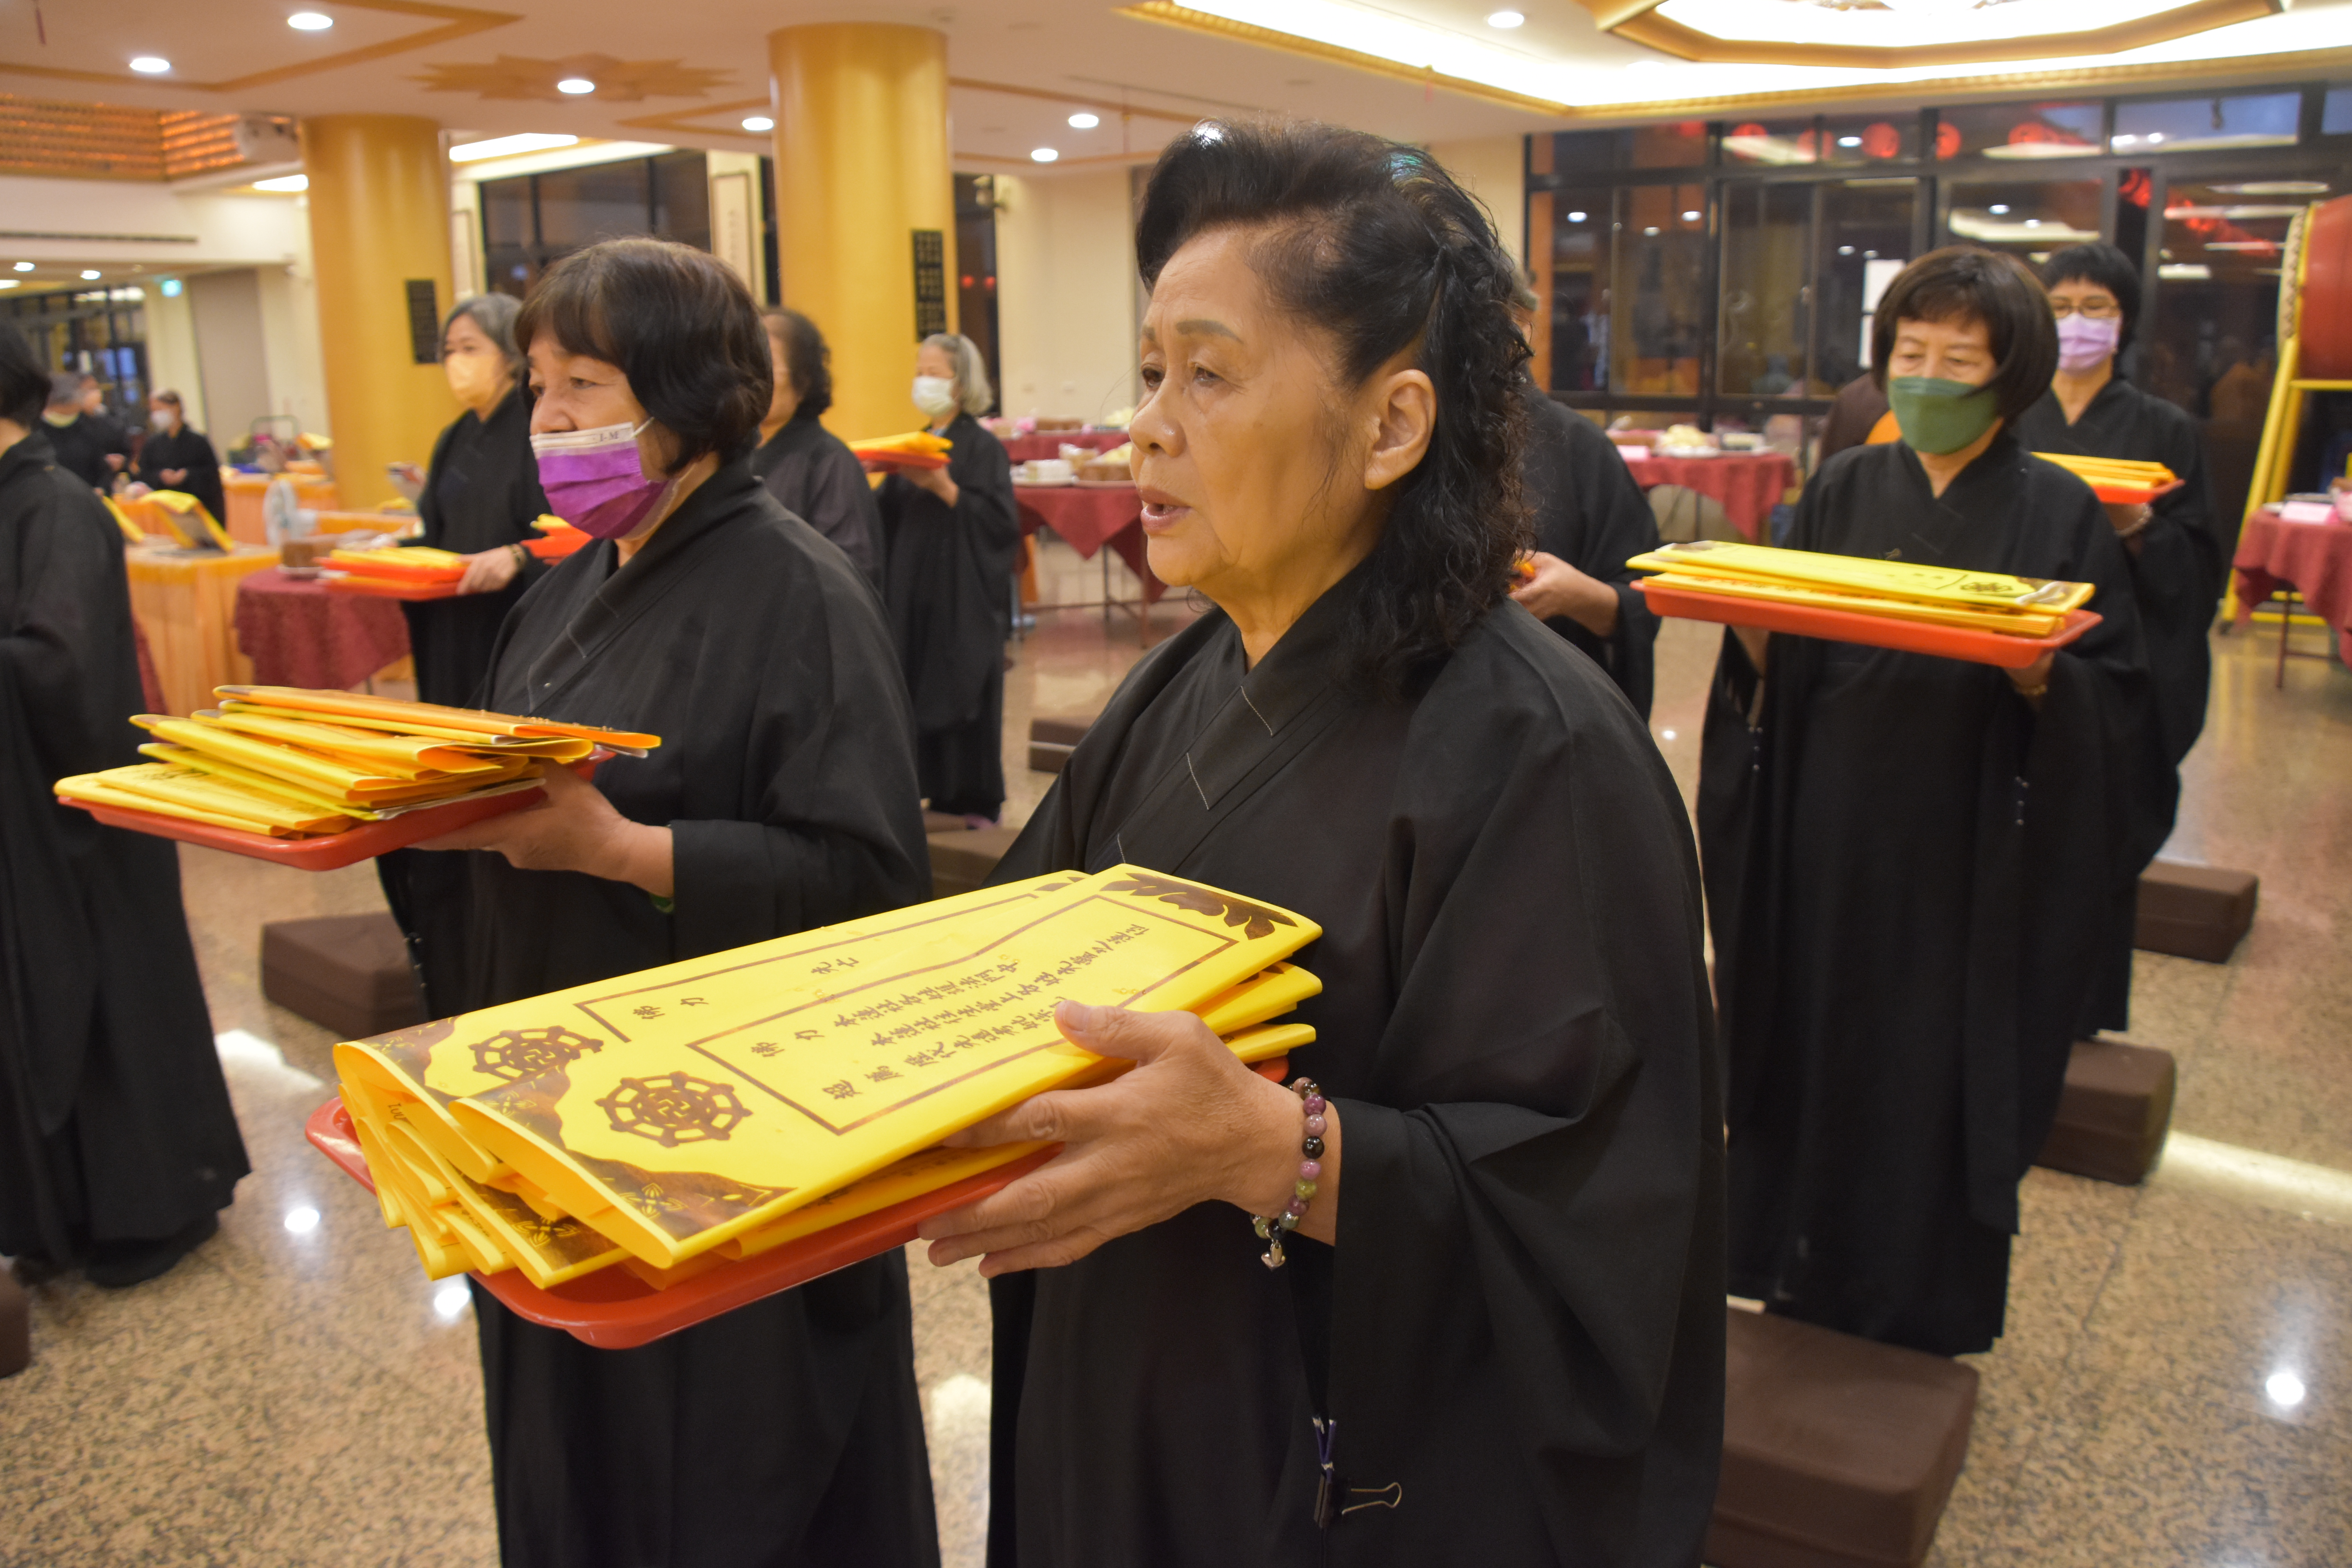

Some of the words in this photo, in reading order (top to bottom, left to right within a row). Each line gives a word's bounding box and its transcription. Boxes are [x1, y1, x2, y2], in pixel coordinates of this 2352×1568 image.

[811, 958, 859, 974] 先亡
[633, 998, 709, 1019] 佛力
[751, 1030, 824, 1057] 佛力
[834, 963, 1018, 1027] 本蓮社各姓護法門中
[822, 1066, 903, 1099] 超薦
[904, 996, 1067, 1067] 歷代先遠考妣宗
